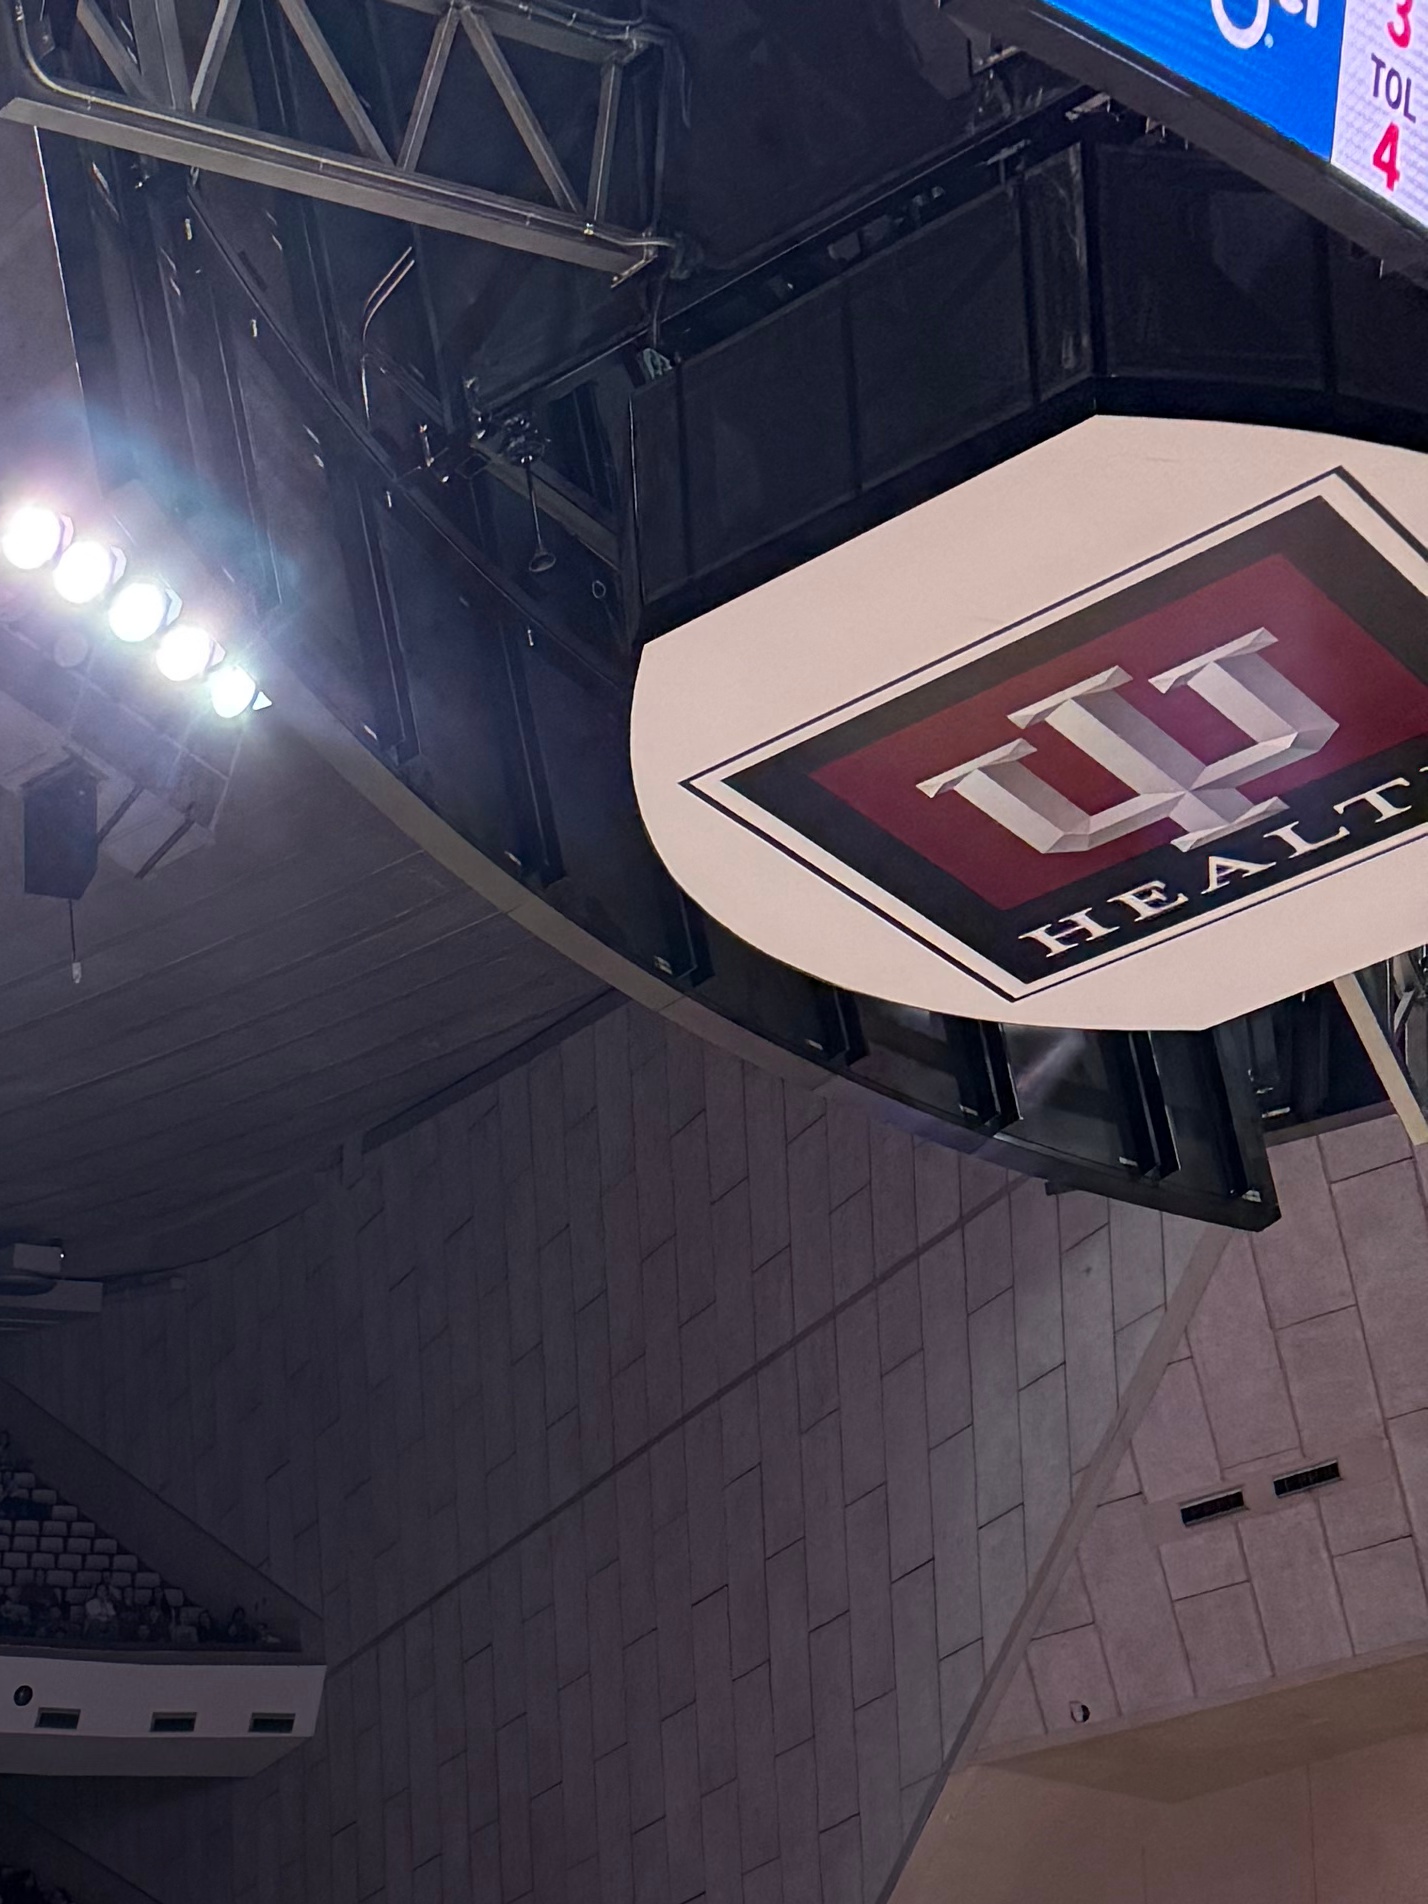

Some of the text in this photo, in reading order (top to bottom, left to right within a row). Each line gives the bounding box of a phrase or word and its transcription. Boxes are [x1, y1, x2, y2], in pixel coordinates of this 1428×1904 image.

[1370, 53, 1417, 123] TOL
[1372, 122, 1401, 192] 4
[1018, 764, 1428, 958] HEALT
